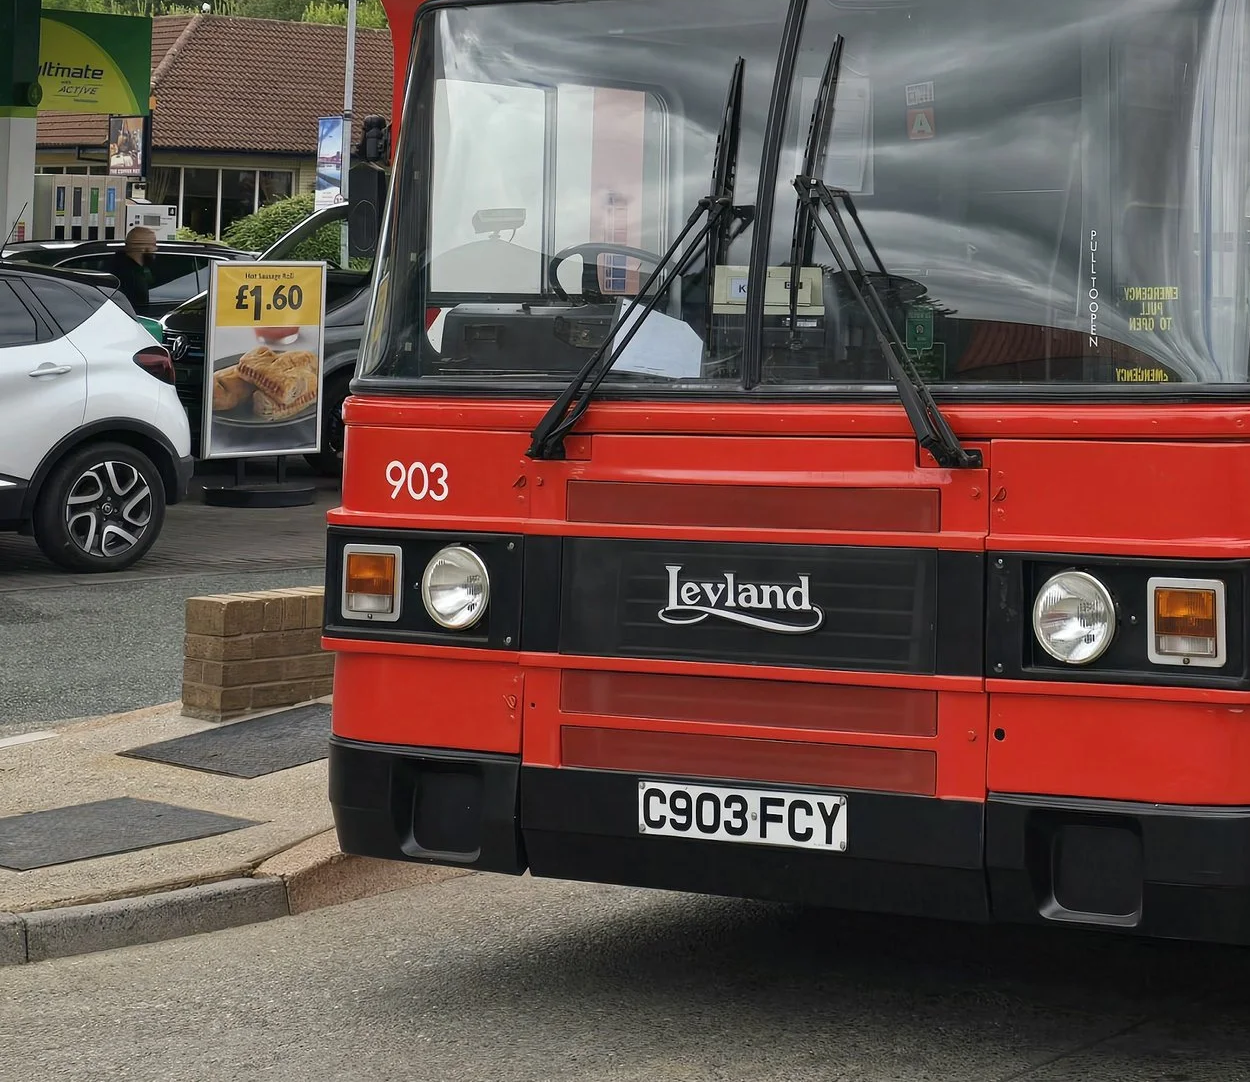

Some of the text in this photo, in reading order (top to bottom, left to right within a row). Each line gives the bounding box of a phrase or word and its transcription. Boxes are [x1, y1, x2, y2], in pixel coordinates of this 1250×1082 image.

[235, 284, 303, 321] £1.60
[1088, 229, 1099, 348] PULL TO OPEN
[385, 460, 450, 503] 903
[661, 564, 820, 621] Leyland
[643, 787, 843, 845] C903 FCY
